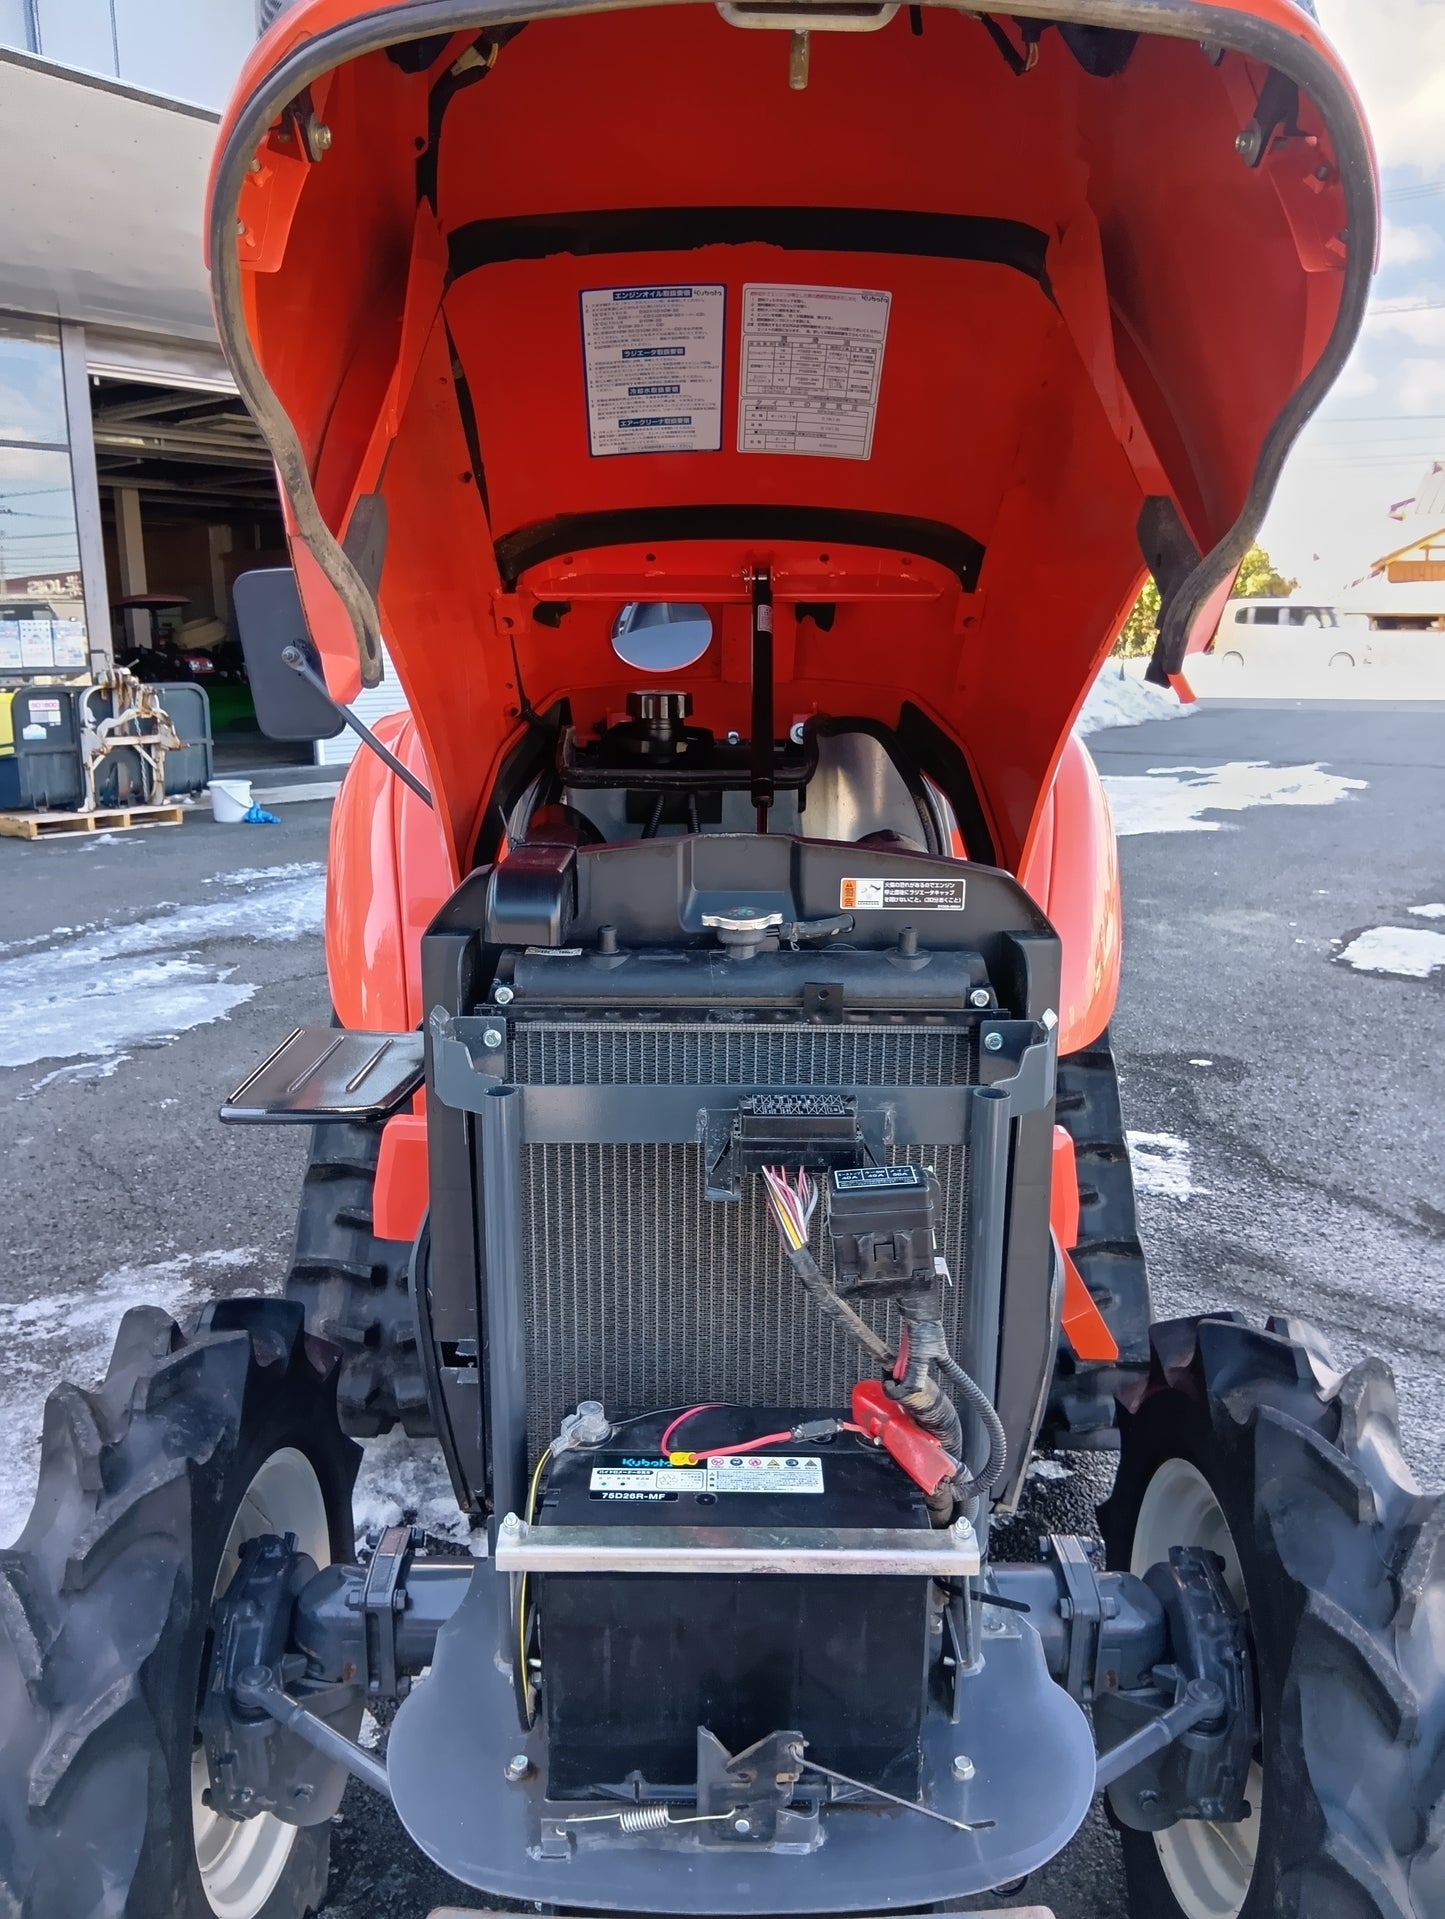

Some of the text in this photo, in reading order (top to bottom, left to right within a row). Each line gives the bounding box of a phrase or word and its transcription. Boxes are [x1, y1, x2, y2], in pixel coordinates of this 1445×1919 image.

[694, 289, 722, 297] Kubota
[861, 295, 889, 304] Kubota
[602, 1492, 666, 1500] 75D26R-MF
